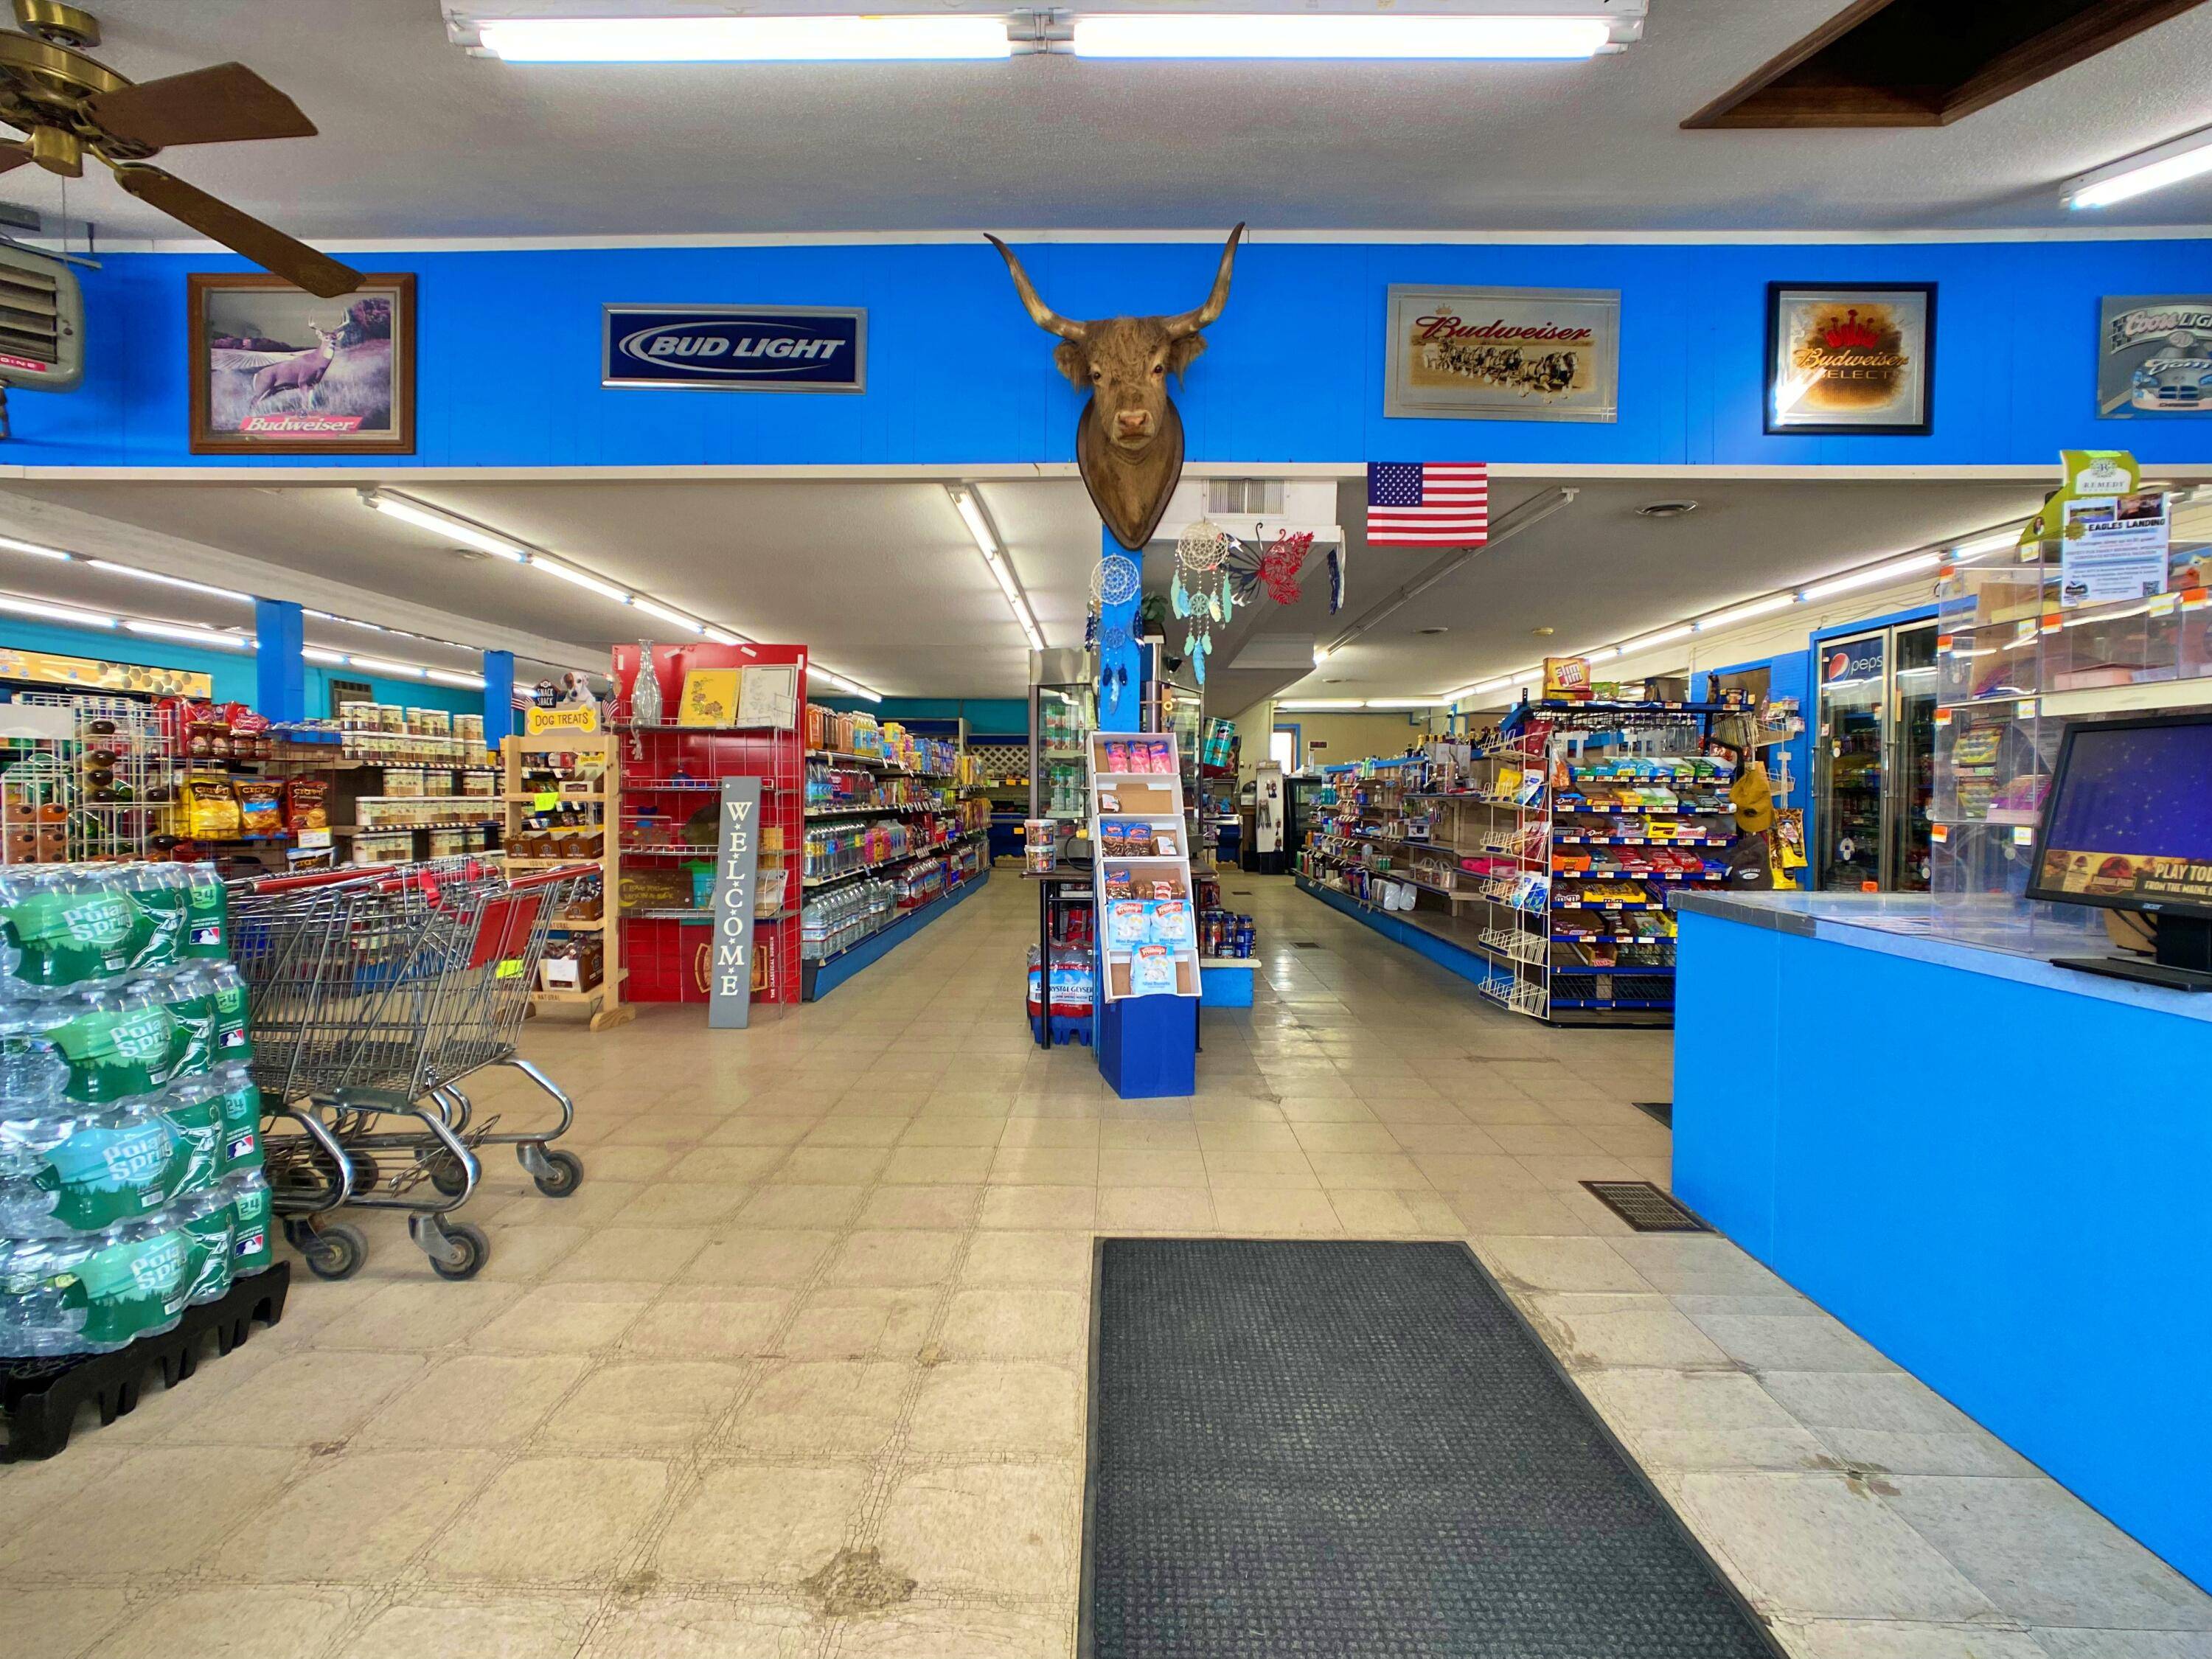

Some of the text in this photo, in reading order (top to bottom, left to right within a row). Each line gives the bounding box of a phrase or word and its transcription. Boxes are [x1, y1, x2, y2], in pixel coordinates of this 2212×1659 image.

[1416, 316, 1591, 341] Budweiser
[648, 337, 846, 358] BUD LIGHT
[1793, 347, 1909, 368] Budweiser
[244, 417, 355, 431] Budweiser
[2088, 518, 2166, 532] EAGLES LANDING
[1851, 655, 1882, 675] peps
[535, 712, 588, 727] DOG TREATS
[2155, 863, 2189, 880] PLAY
[194, 888, 214, 901] 24
[2144, 880, 2206, 894] FROM THE MAINE
[717, 801, 752, 995] WELCOME
[226, 1096, 243, 1111] 24
[240, 1198, 260, 1213] 24
